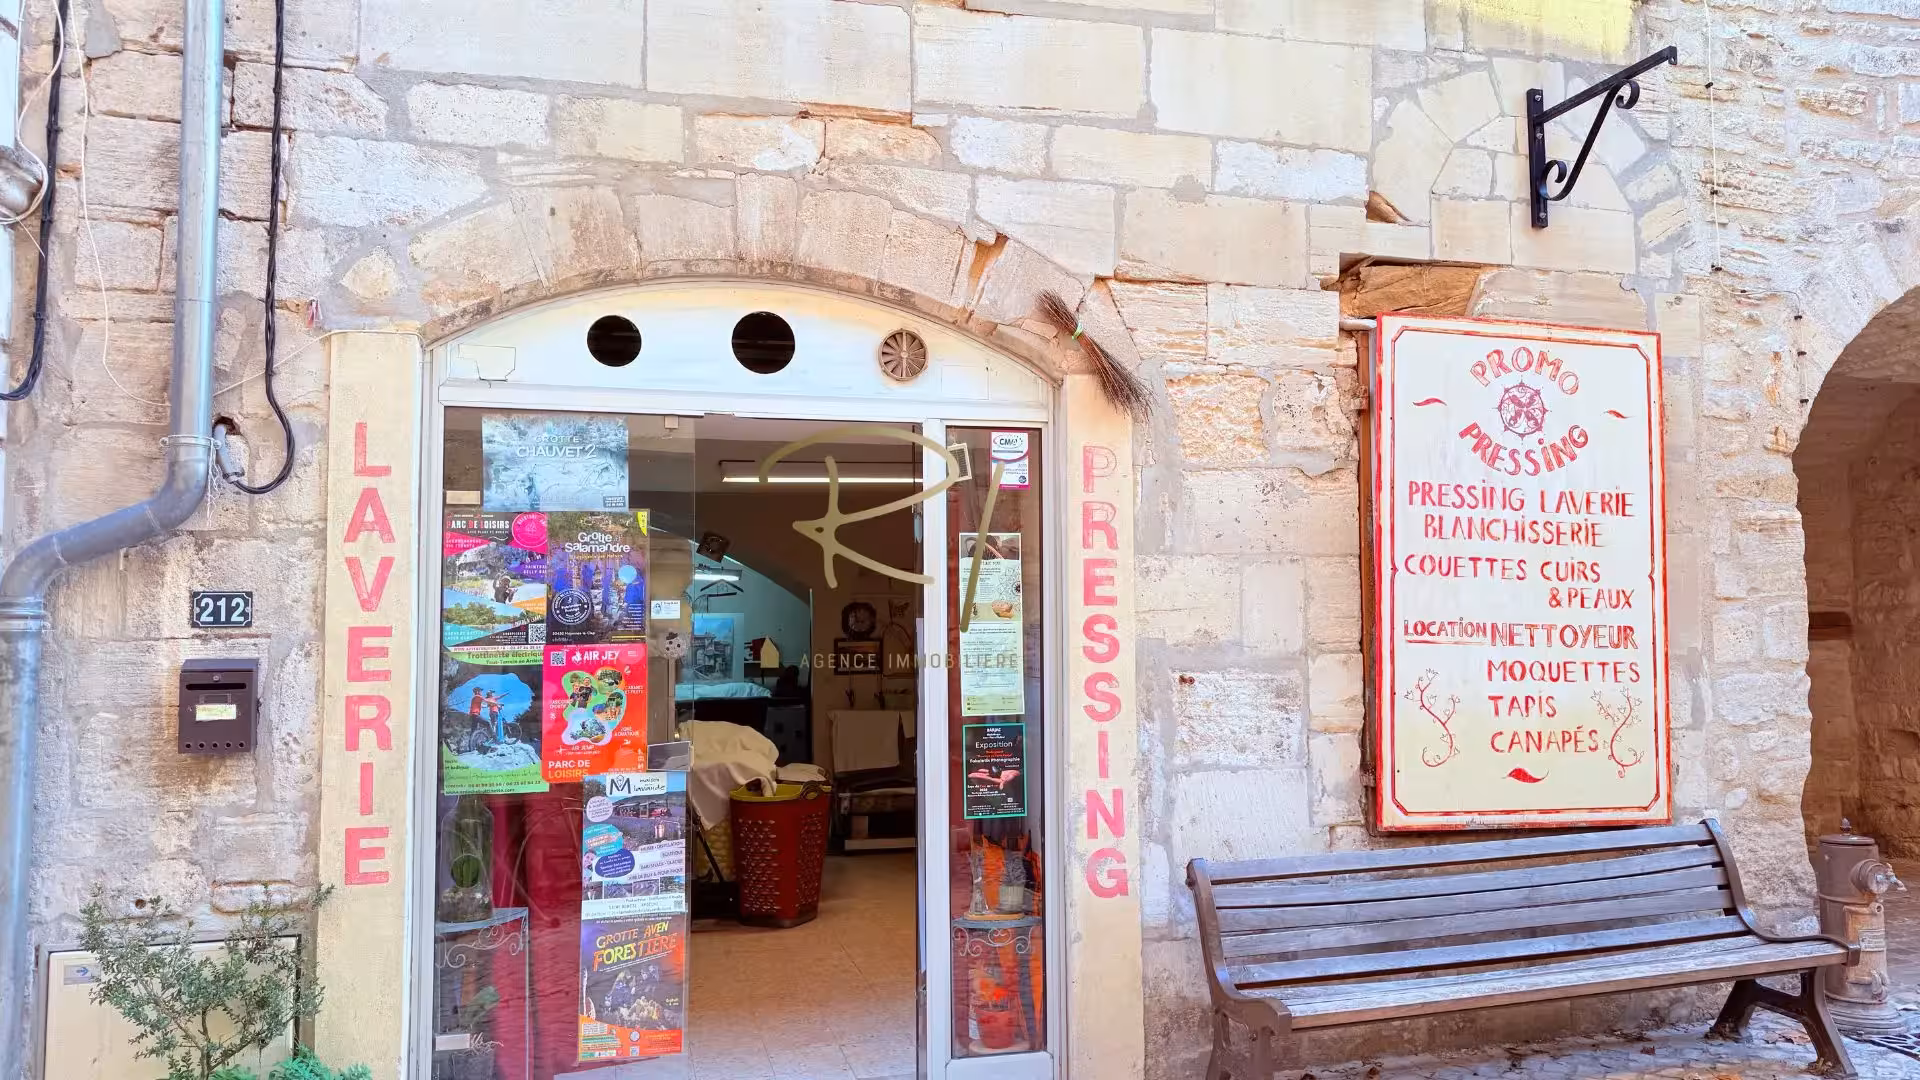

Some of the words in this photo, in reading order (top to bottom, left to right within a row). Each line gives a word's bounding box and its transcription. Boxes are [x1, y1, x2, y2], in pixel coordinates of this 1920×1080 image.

[1470, 347, 1579, 395] PROMO
[516, 446, 581, 458] CHAUVET
[584, 444, 597, 459] 2
[1540, 486, 1636, 517] LAVERIE
[480, 520, 510, 529] LOISIRS
[578, 532, 613, 543] Grotte
[1424, 514, 1606, 548] BLANCHISSERIE
[565, 543, 630, 553] Salamandre
[1404, 555, 1528, 581] COUETTES
[1540, 556, 1600, 583] CUIRS
[200, 597, 245, 622] 212
[1490, 623, 1639, 650] NETTOYEUR
[343, 421, 395, 886] LAVERIE
[583, 651, 599, 661] AIR
[601, 651, 619, 661] JEY
[1081, 445, 1129, 899] PRESSING
[1487, 660, 1641, 683] MOQUETTES
[1488, 690, 1557, 718] TAPIS
[975, 741, 1013, 749] Exposition
[1490, 725, 1599, 753] CANAPÉS
[548, 760, 575, 769] PARC
[577, 760, 590, 768] DE
[548, 769, 589, 779] LOISIRS
[596, 928, 639, 949] GROTTE
[643, 921, 669, 938] AVEN
